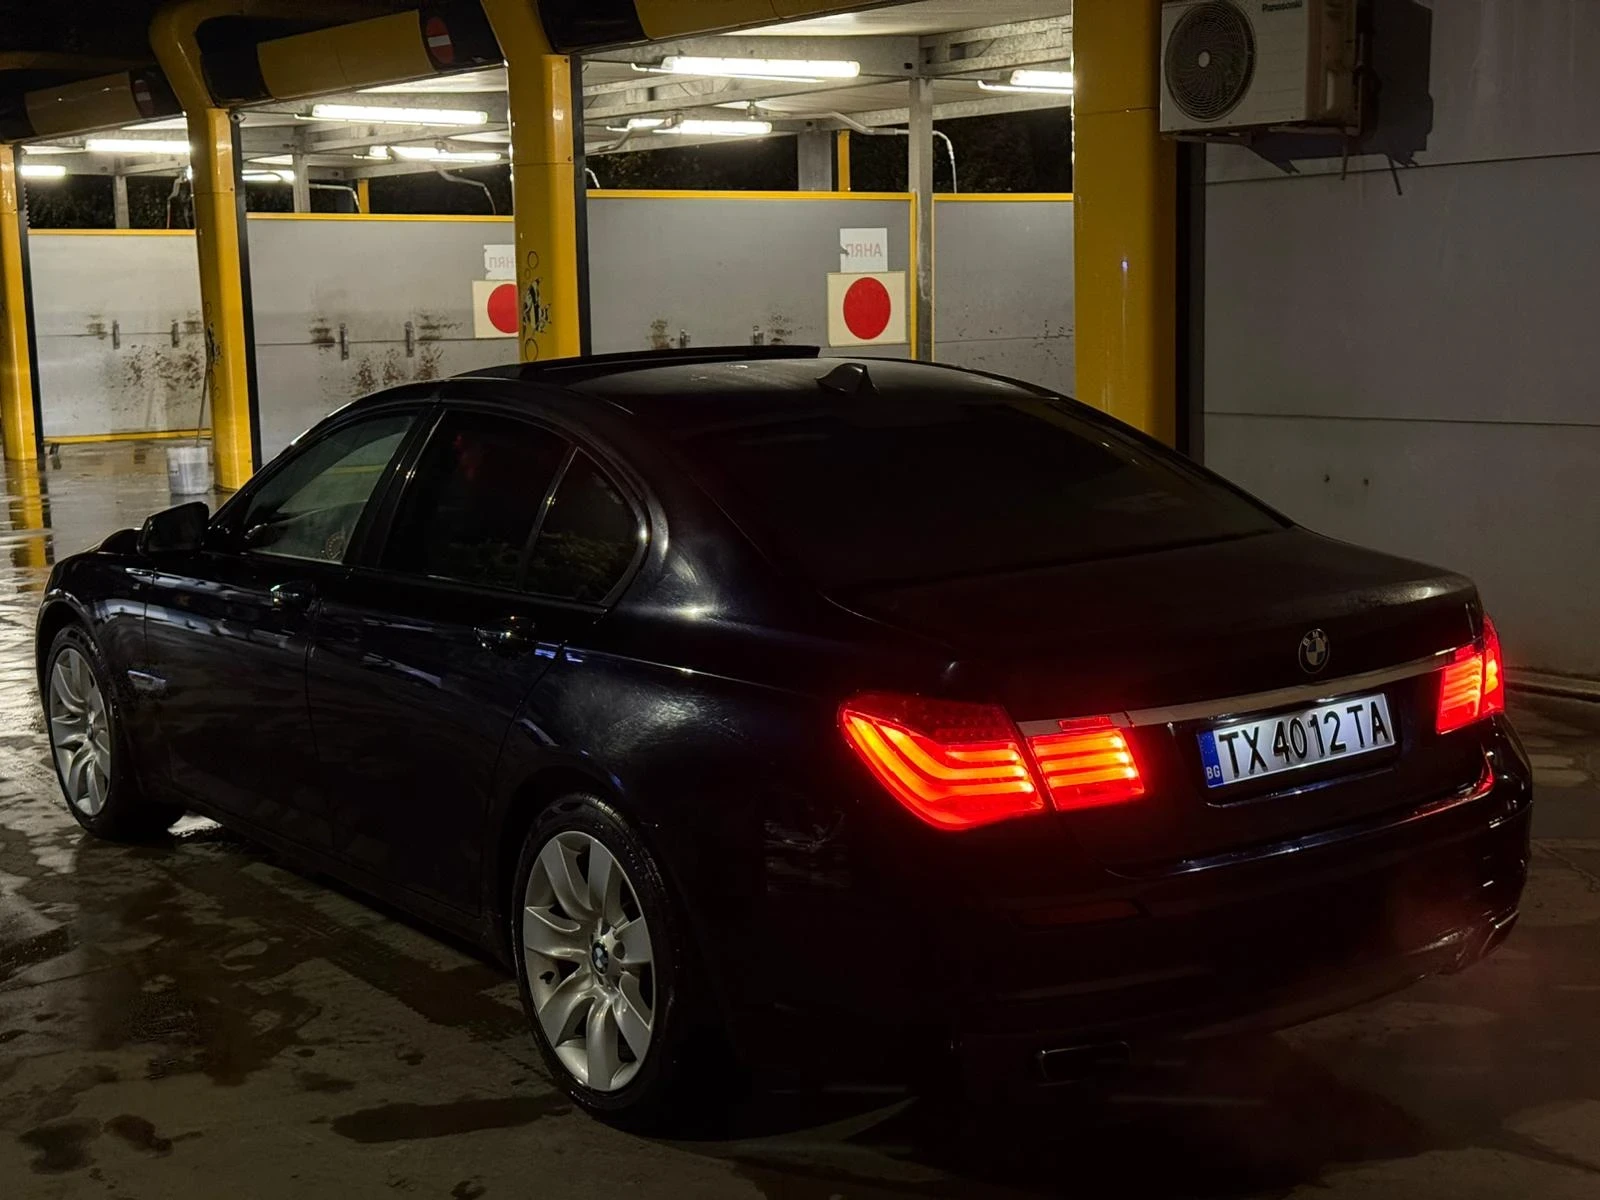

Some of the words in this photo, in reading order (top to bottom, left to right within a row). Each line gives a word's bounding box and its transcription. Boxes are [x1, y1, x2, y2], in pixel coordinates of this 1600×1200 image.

[489, 257, 514, 269] ПЯН
[1218, 726, 1268, 778] TX
[1272, 711, 1346, 764] 4012
[1346, 701, 1389, 748] TA
[1206, 764, 1220, 779] BG
